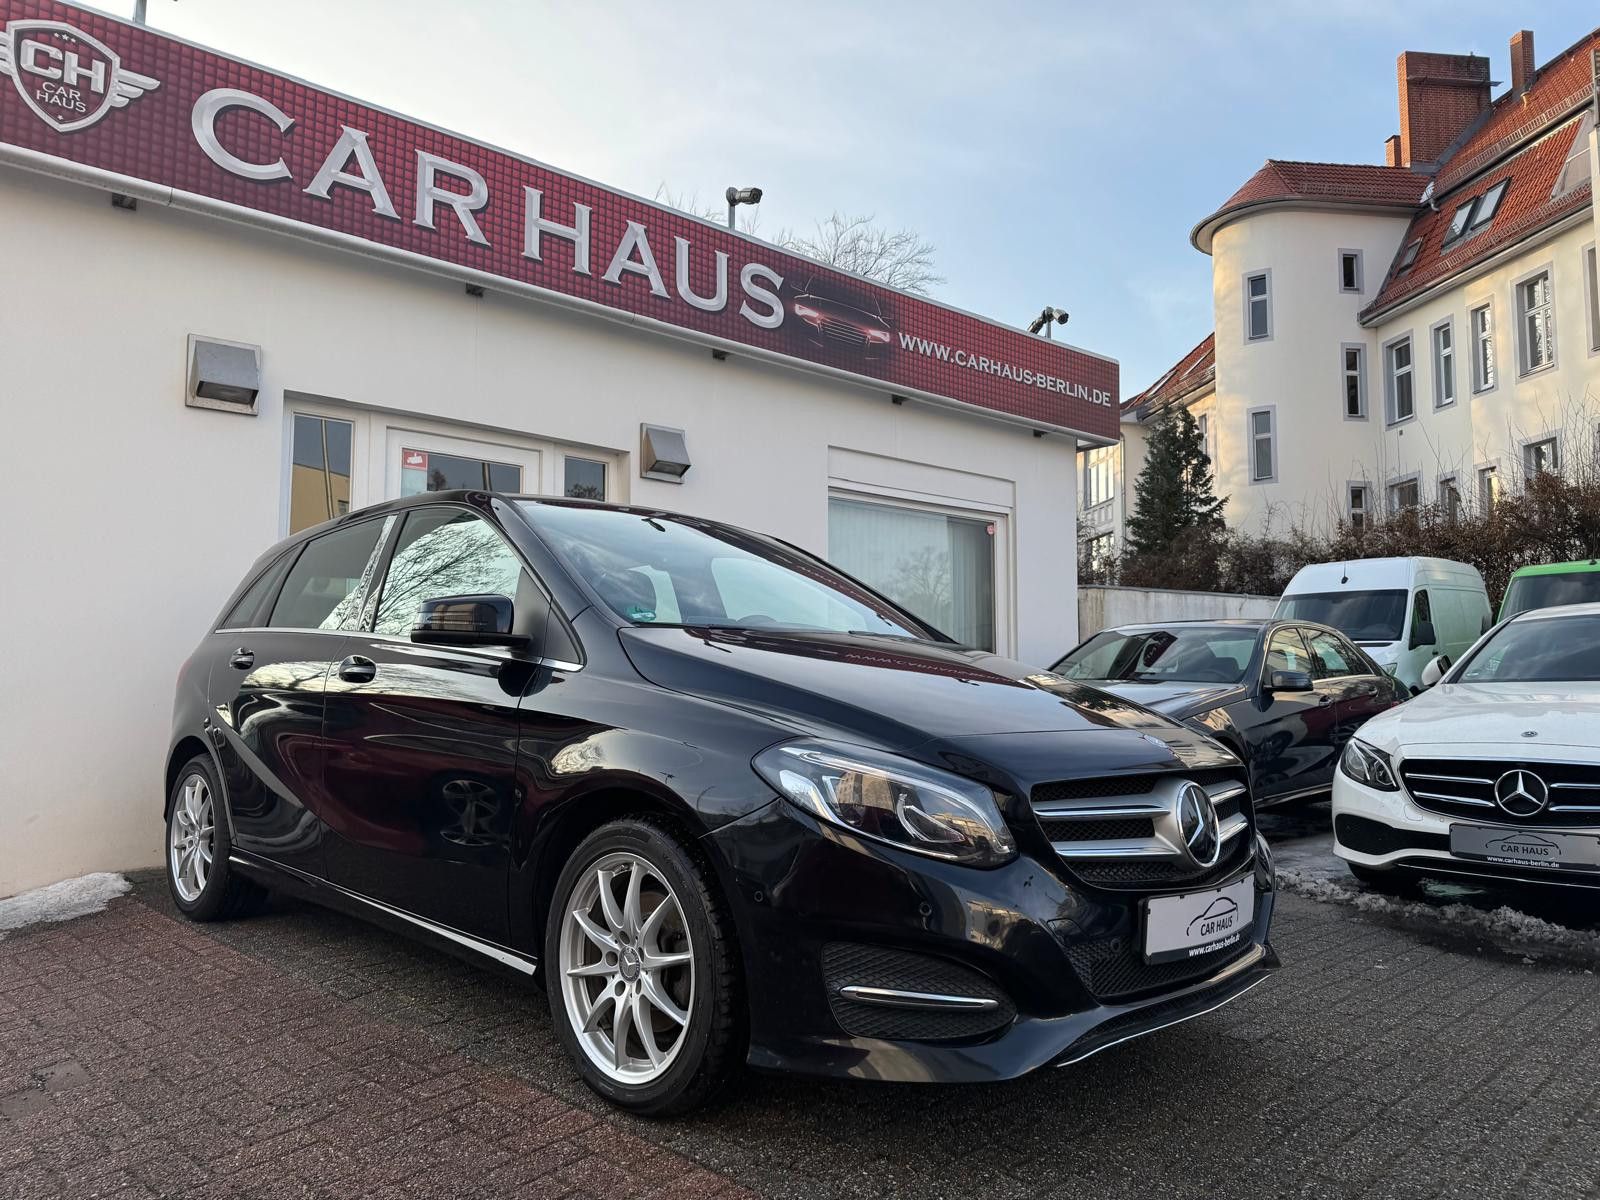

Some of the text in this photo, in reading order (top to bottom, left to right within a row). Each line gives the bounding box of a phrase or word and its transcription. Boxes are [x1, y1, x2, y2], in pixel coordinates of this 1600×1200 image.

[20, 39, 106, 94] CH
[36, 90, 87, 113] HAUS
[42, 81, 81, 101] CAR
[191, 87, 785, 329] CAR HAUS
[898, 331, 1112, 408] WWW.CARHAUS-BERLIN.DE
[1501, 845, 1549, 856] CAR HAUS
[1486, 856, 1559, 868] www.carhaus-berlin.de
[1200, 916, 1233, 936] CAR HAUS
